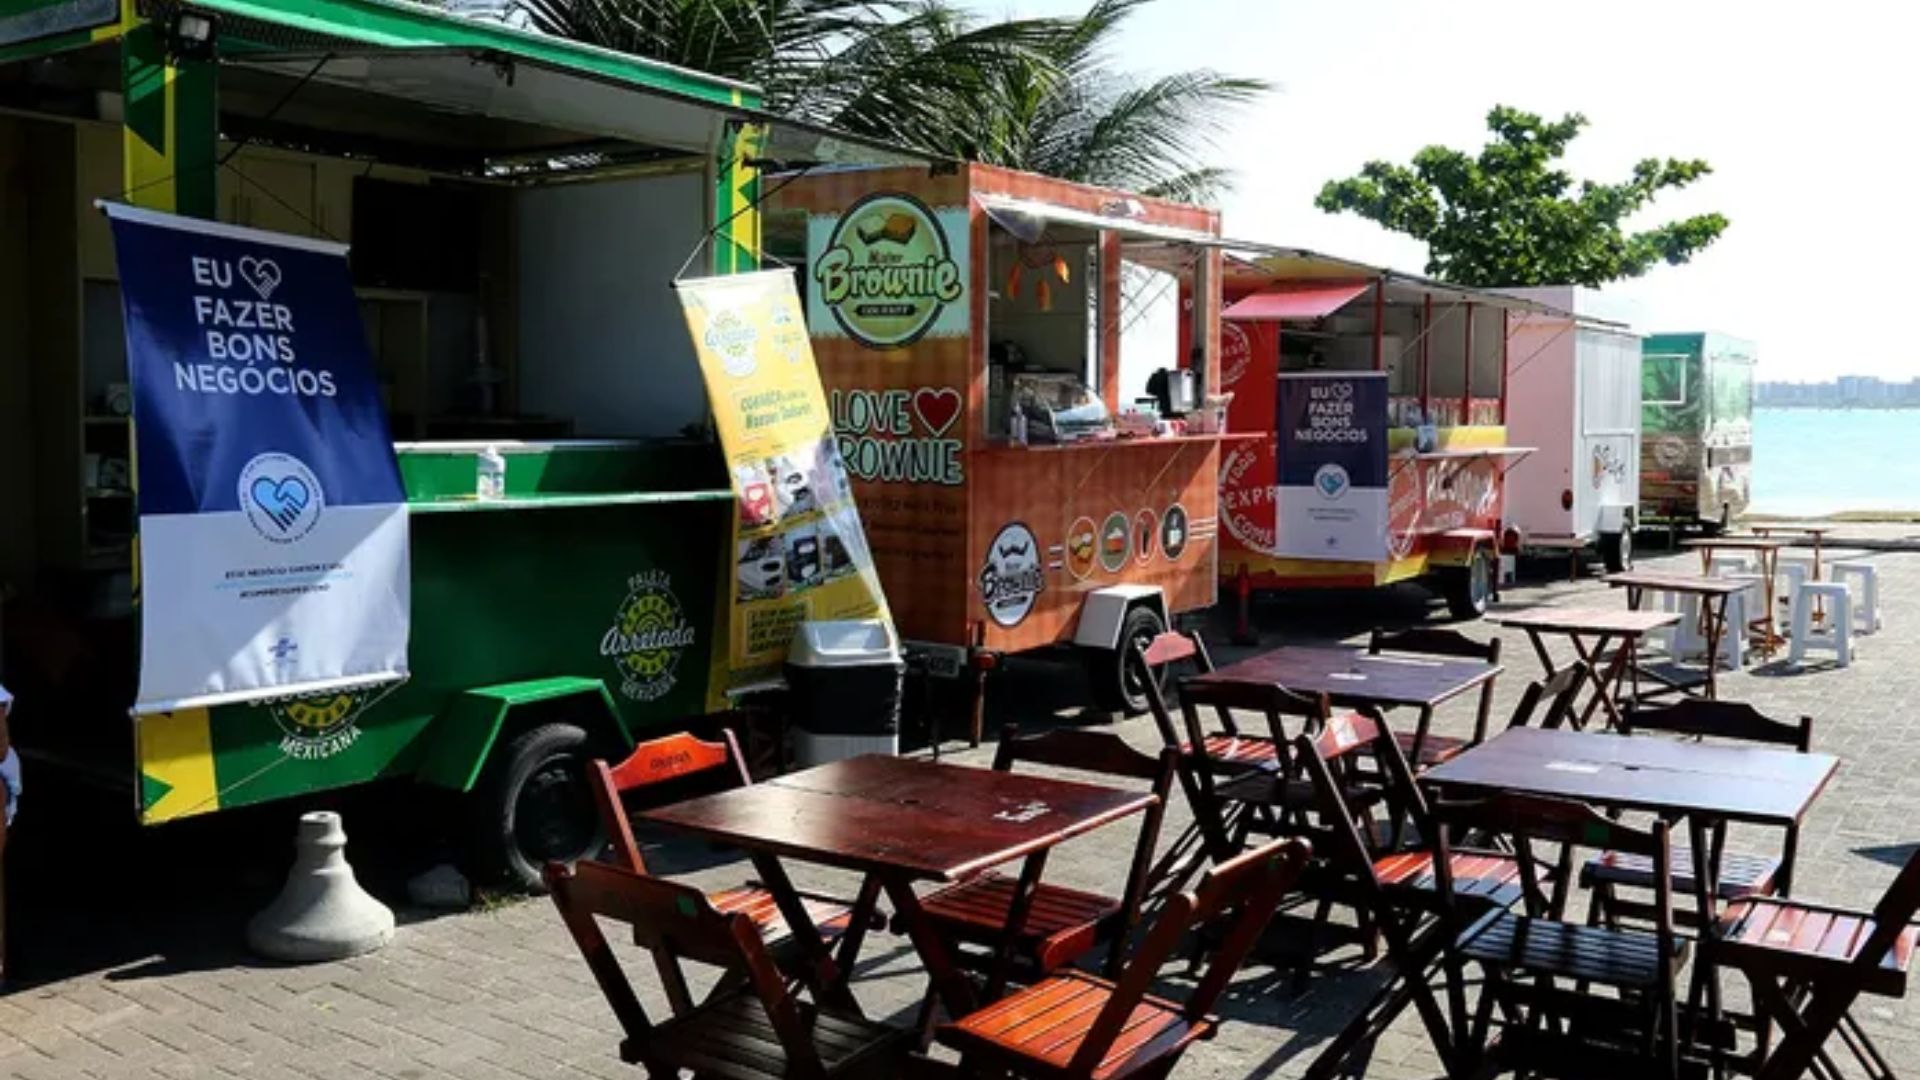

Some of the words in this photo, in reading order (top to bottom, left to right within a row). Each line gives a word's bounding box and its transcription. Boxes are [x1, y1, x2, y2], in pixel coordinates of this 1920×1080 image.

[191, 256, 233, 287] EU
[815, 243, 963, 306] Brownie
[194, 295, 295, 332] FAZER
[206, 330, 295, 363] BONS
[173, 357, 338, 397] NEGÓCIOS
[1310, 386, 1330, 400] EU
[831, 388, 913, 434] LOVE
[1307, 402, 1354, 416] FAZER
[1310, 416, 1351, 428] BONS
[837, 434, 965, 485] ROWNIE
[1224, 487, 1278, 509] EXPR
[277, 725, 363, 761] MEXICANA
